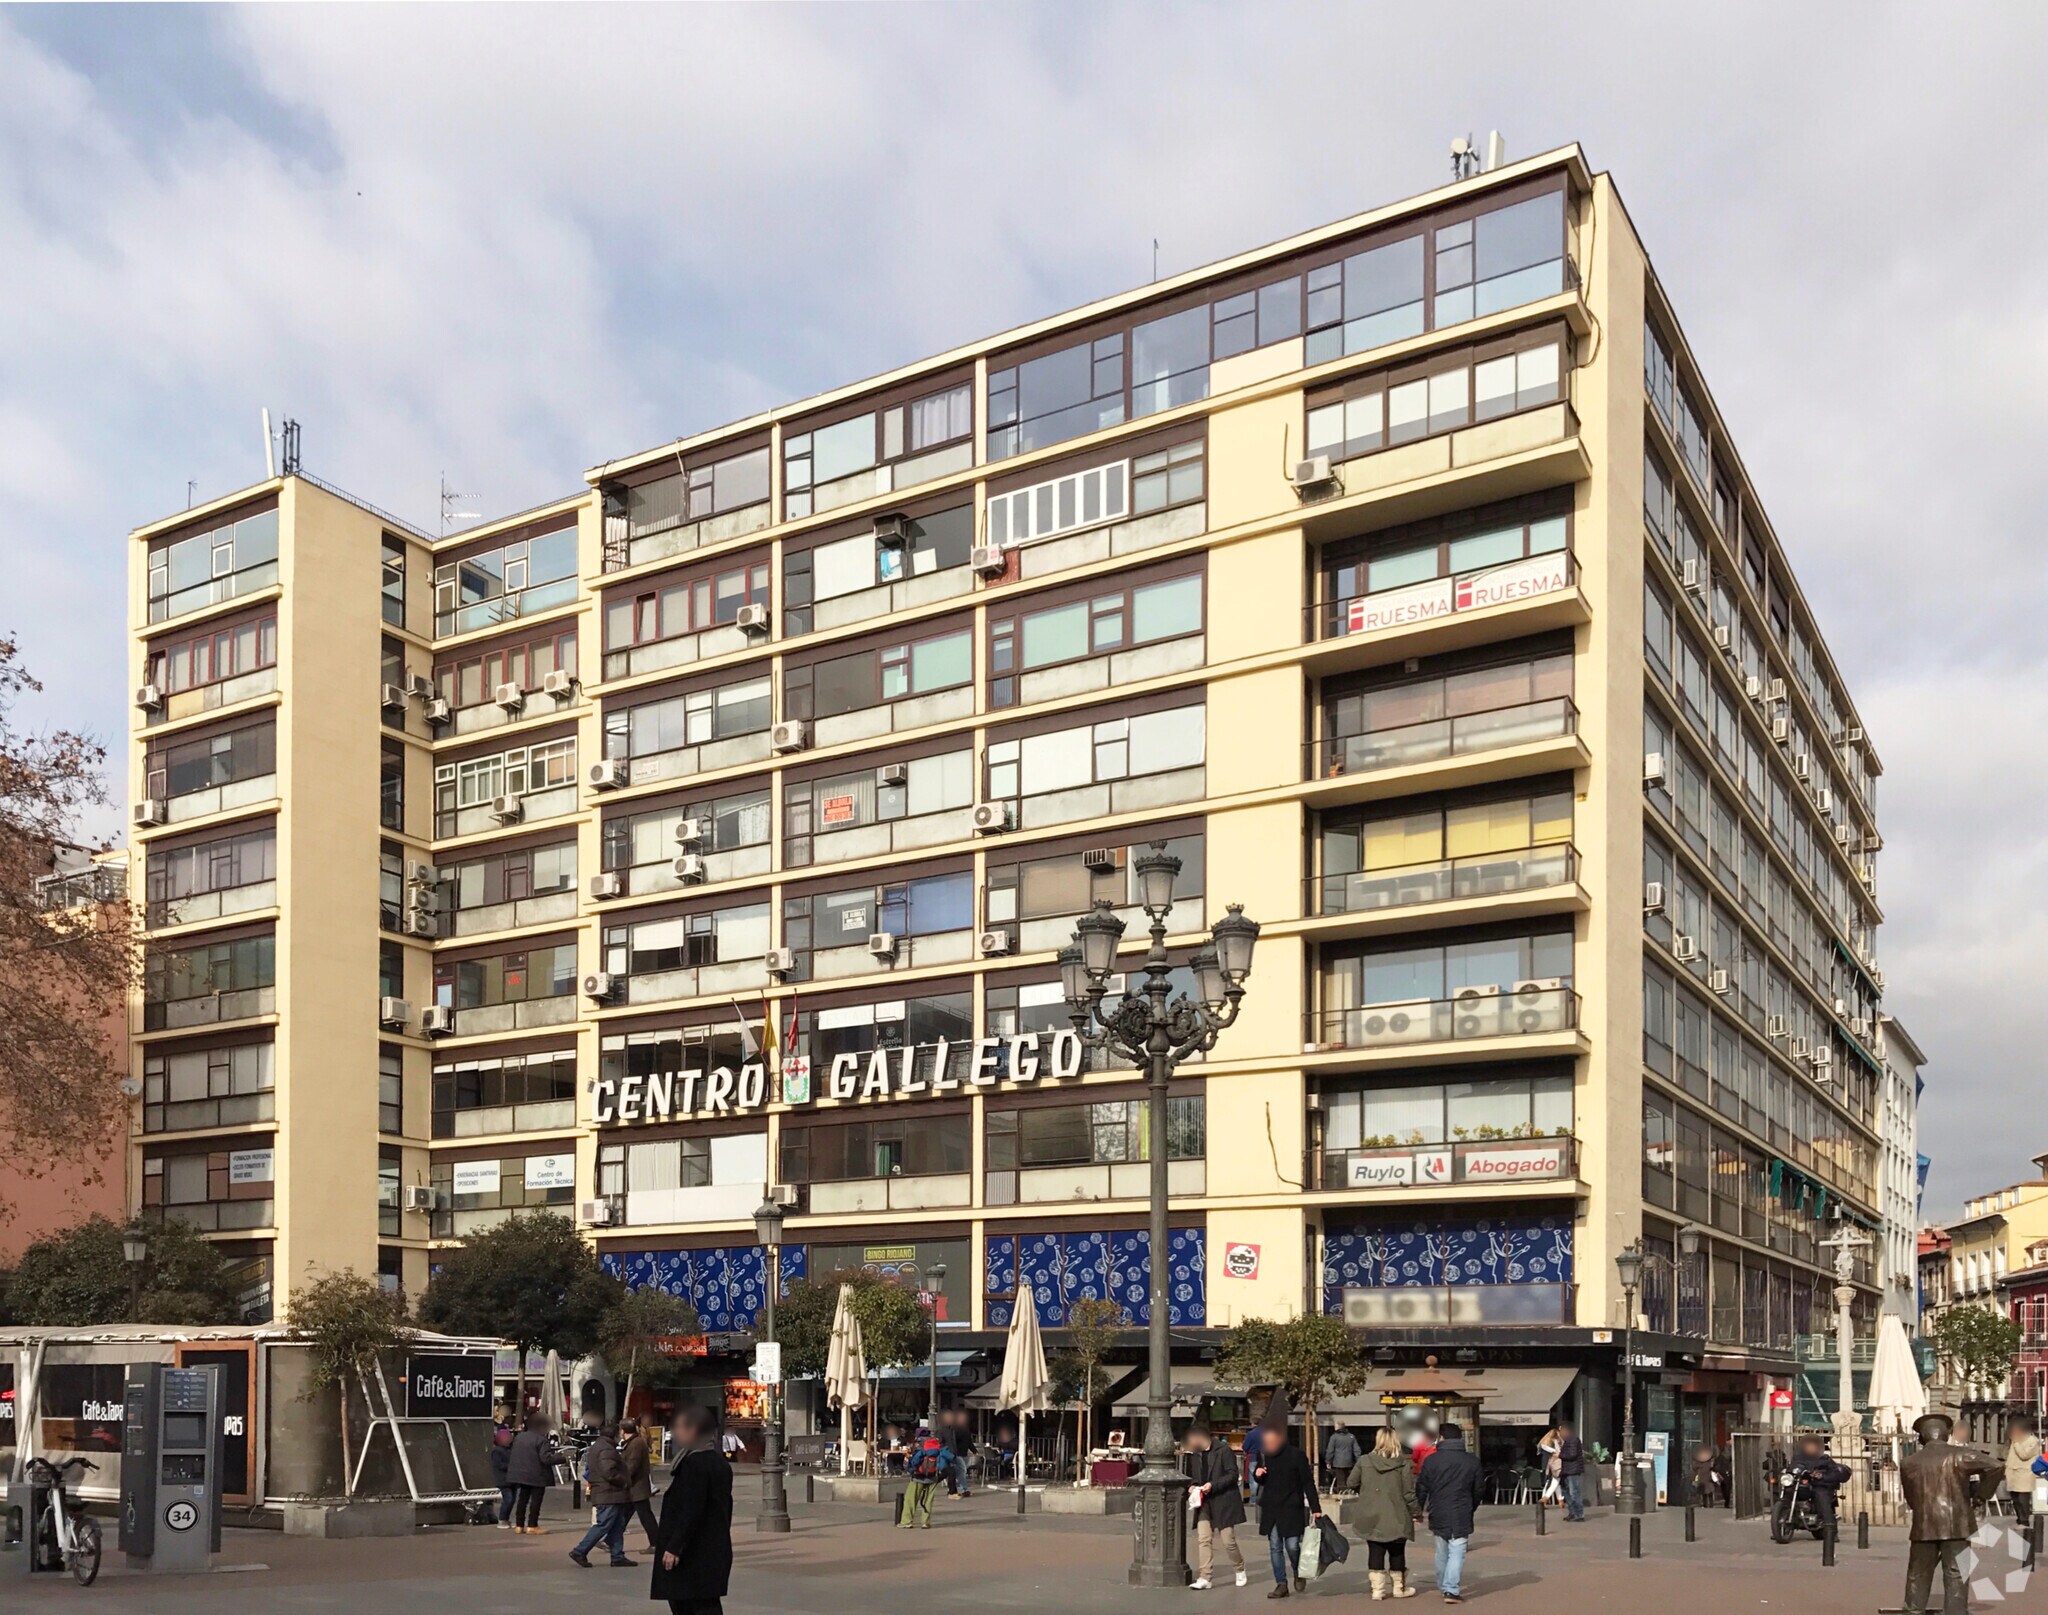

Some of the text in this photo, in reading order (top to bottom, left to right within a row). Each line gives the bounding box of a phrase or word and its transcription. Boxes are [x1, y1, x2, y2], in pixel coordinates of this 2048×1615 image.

[1475, 573, 1563, 605] RUESMA
[1367, 599, 1449, 628] RUESMA
[592, 1030, 1082, 1123] CENTRO GALLEGO
[1355, 1165, 1405, 1182] Ruylo
[1468, 1157, 1558, 1175] Abogado
[867, 1249, 912, 1260] BINGO RIOJANO
[1642, 1354, 1661, 1367] Tapas
[172, 1510, 192, 1522] 34
